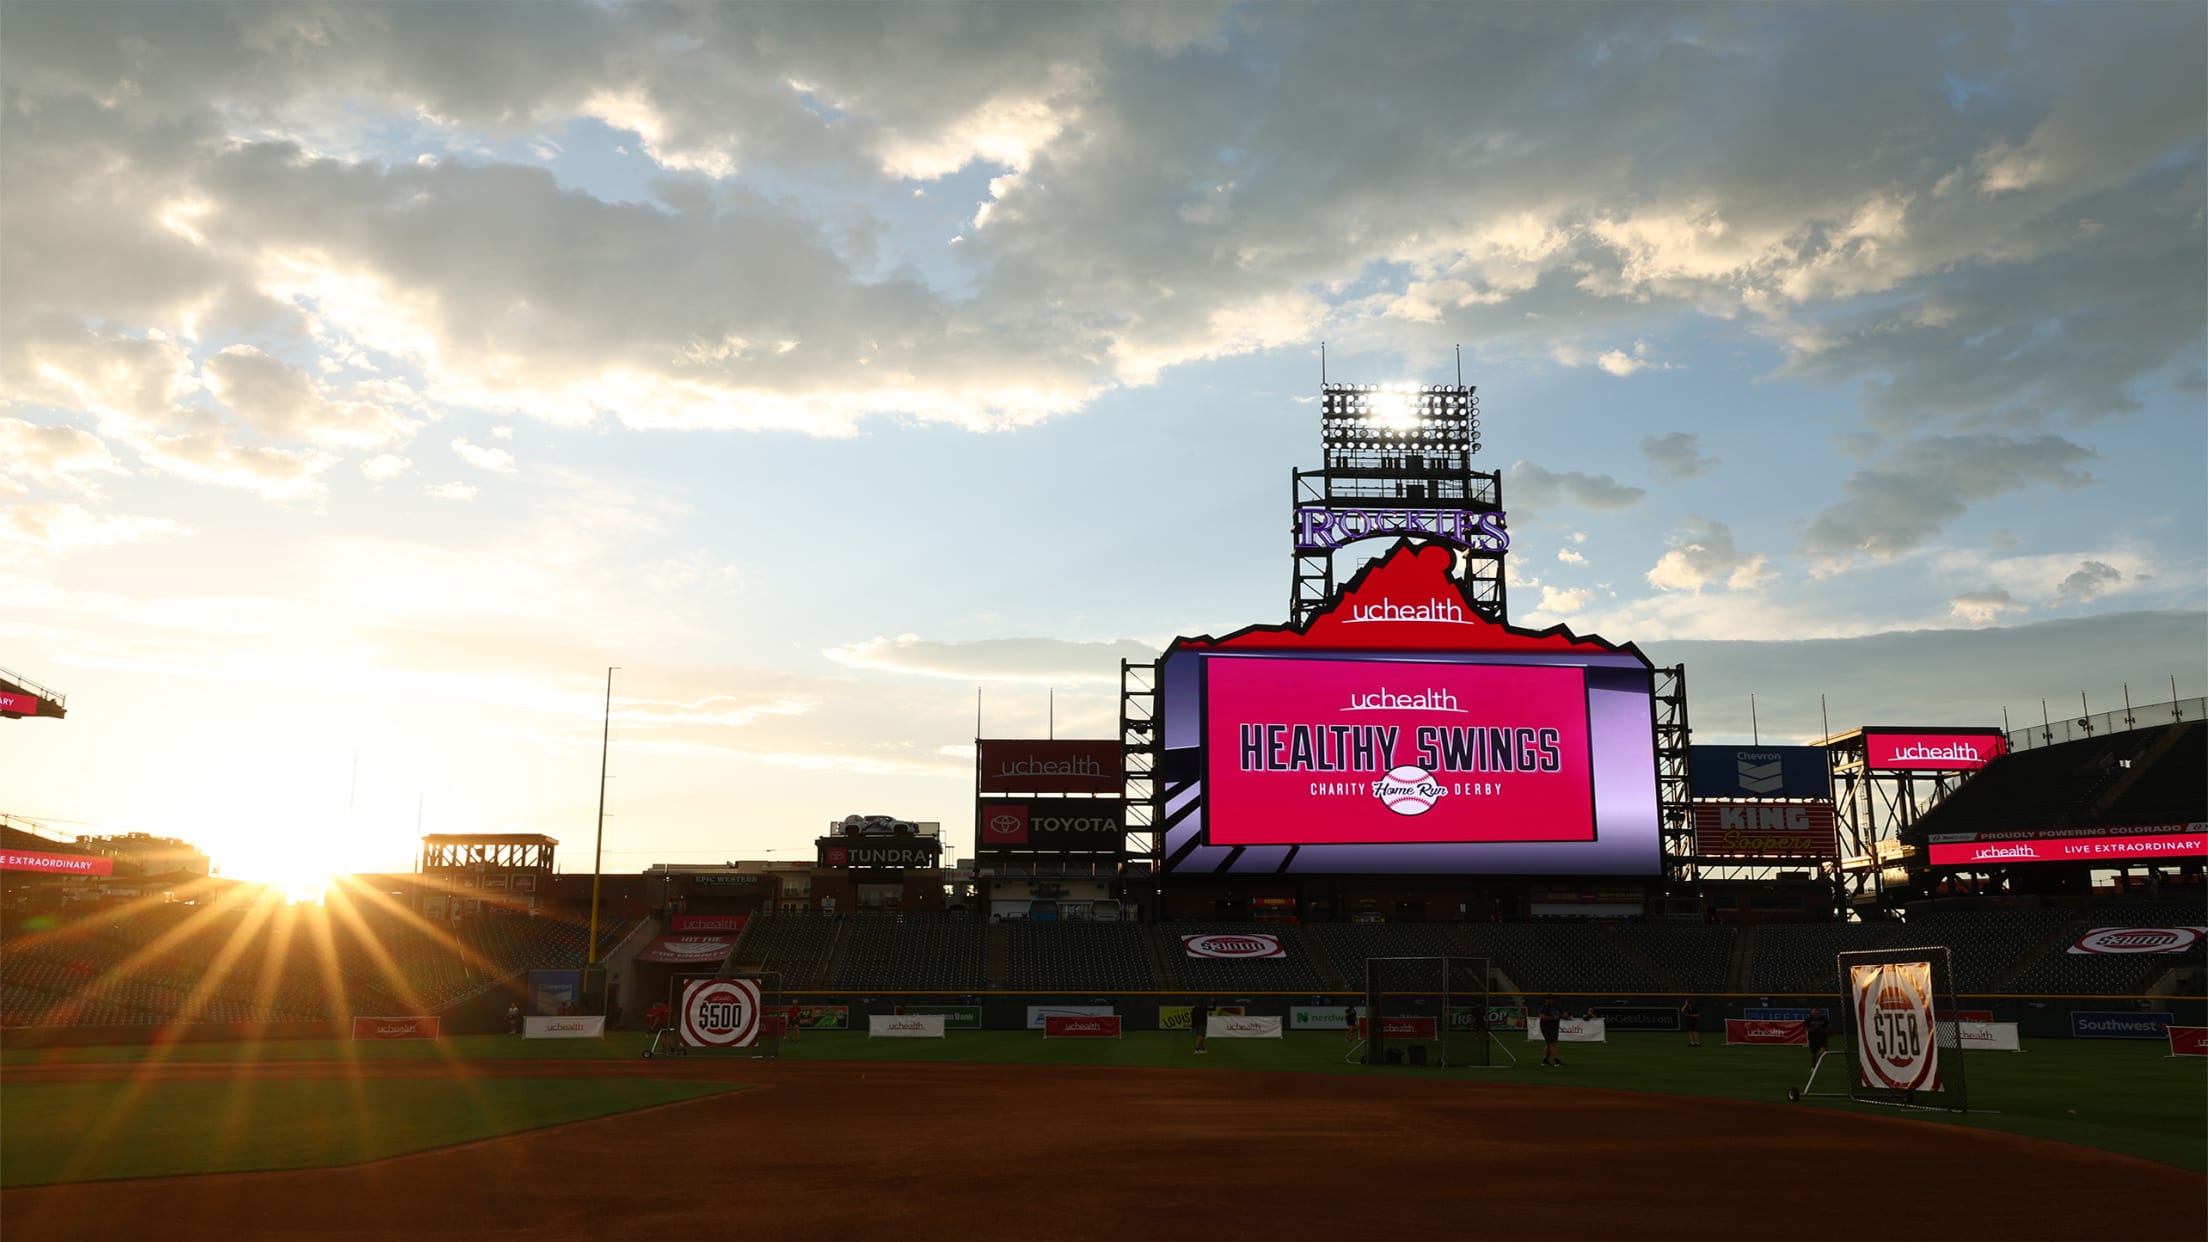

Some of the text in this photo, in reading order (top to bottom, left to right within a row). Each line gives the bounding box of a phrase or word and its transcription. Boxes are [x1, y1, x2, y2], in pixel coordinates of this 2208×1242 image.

[1295, 508, 1510, 552] ROCKIES
[1353, 597, 1463, 621] uchealth
[1351, 687, 1457, 710] uchealth
[1239, 723, 1562, 773] HEALTHY SWINGS
[1736, 752, 1781, 760] Chevron
[1895, 741, 1978, 760] uchealth
[1001, 754, 1101, 777] uchealth
[1310, 781, 1502, 798] CHARITY Home Run DERBY
[1031, 817, 1118, 832] TOYOTA
[1720, 806, 1809, 830] KING
[1980, 831, 2035, 840] PROUDLY
[2039, 827, 2106, 838] POWERING
[2110, 824, 2182, 834] COLORADO
[1723, 830, 1812, 853] Soopers
[1975, 841, 2201, 858] uchealth LIVE EXTRAORDINARY
[9, 856, 92, 869] EXTRAORDINARY
[848, 849, 927, 863] TUNDRA
[683, 919, 737, 930] uchealth
[699, 1002, 742, 1030] $500
[1162, 1012, 1192, 1028] LOUIS
[1065, 1022, 1101, 1031] uchealth
[1747, 1028, 1785, 1038] uchealth
[2078, 1018, 2158, 1032] Southwest
[1873, 1009, 1921, 1059] $750
